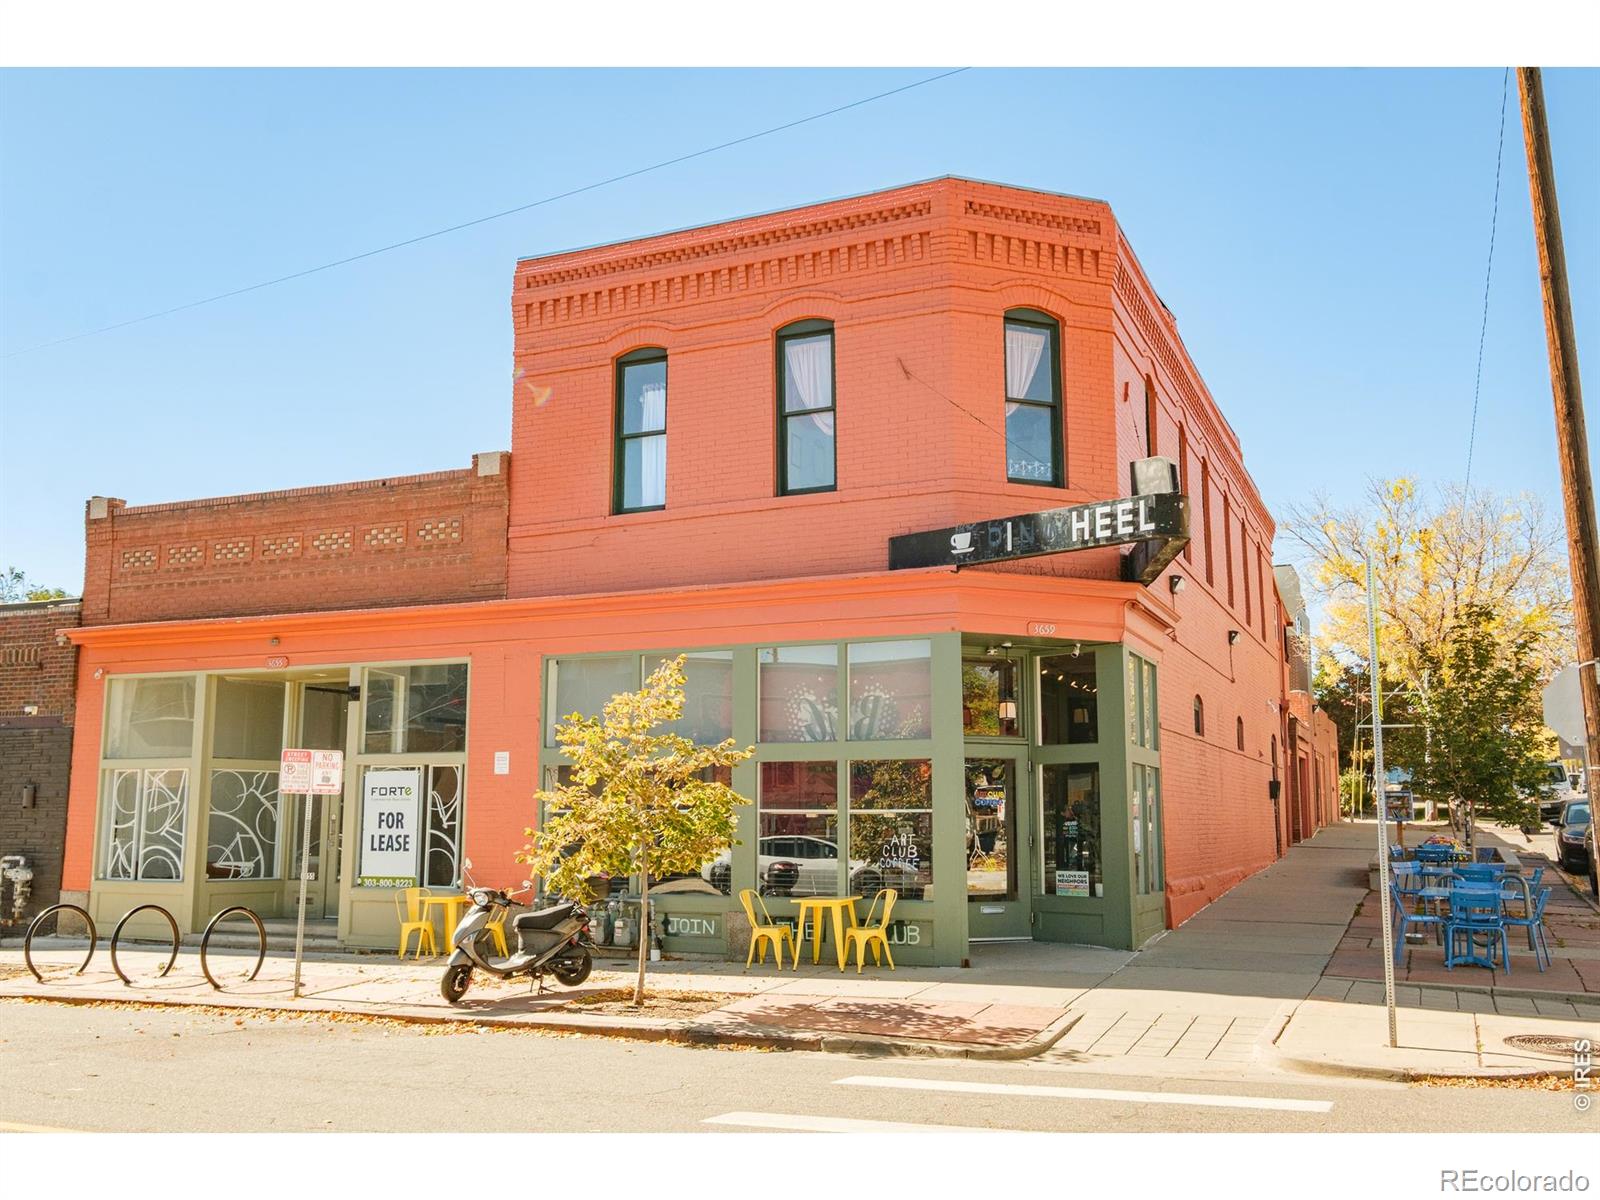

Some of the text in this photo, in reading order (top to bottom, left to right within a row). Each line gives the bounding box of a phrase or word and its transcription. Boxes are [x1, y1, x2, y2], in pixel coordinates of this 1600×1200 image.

[1034, 623, 1056, 634] 3659
[322, 753, 333, 762] NO
[315, 761, 340, 769] PARKING
[378, 812, 404, 829] FOR
[370, 834, 410, 852] LEASE
[890, 832, 916, 847] ART
[882, 844, 918, 858] CLUB
[879, 857, 920, 871] COFFEE
[363, 877, 413, 888] 303-800-8223
[668, 917, 715, 935] JOIN
